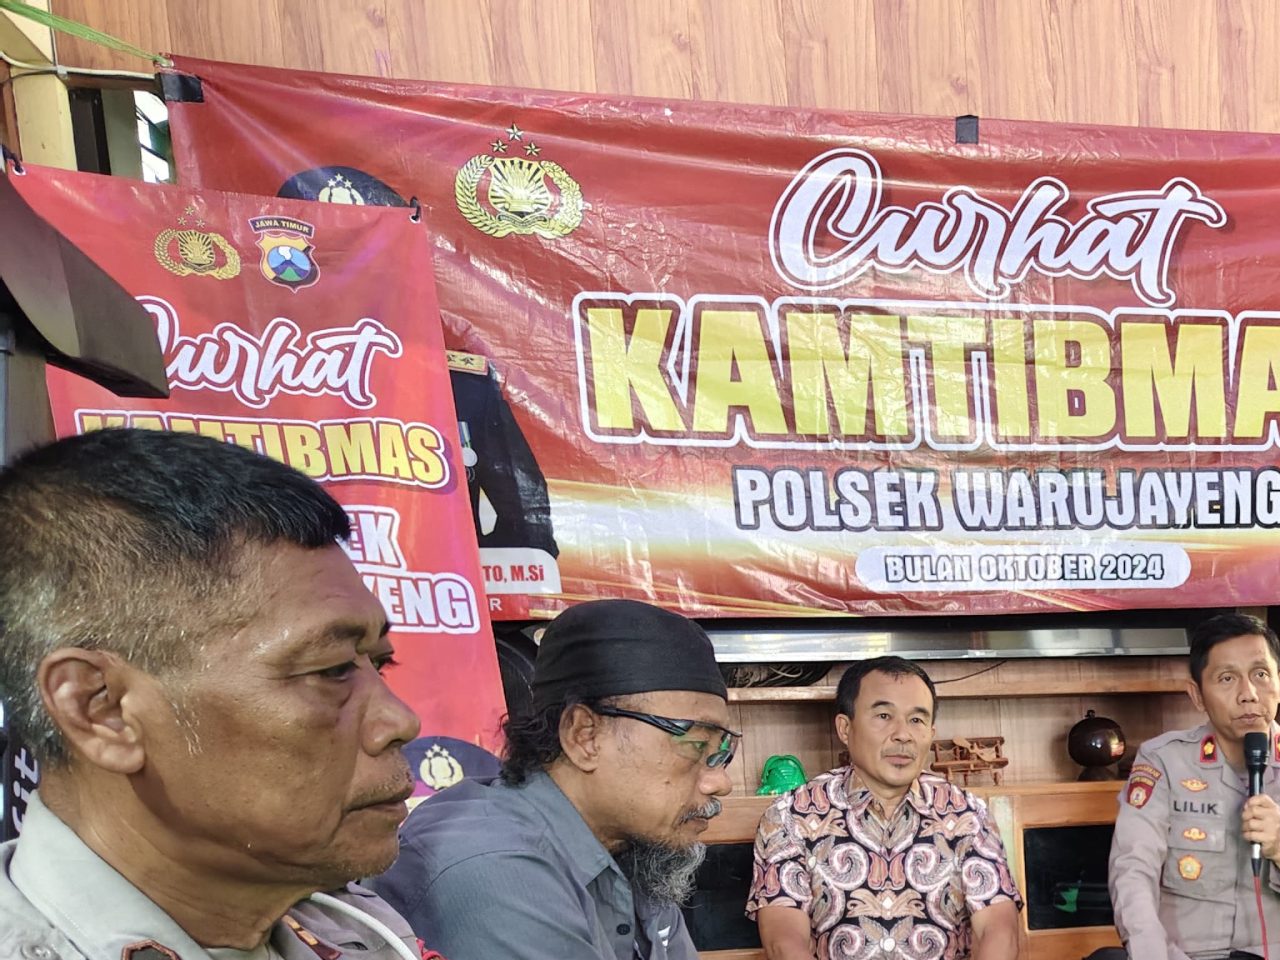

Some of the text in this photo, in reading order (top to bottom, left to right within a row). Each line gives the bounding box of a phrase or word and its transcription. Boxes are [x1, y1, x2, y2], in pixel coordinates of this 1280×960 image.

[255, 219, 309, 233] JAWA TIMUR
[771, 149, 1226, 305] Curhat
[735, 466, 943, 532] POLSEK
[510, 565, 544, 581] M.Si
[886, 554, 1165, 583] BULAN OKTOBER 2024
[1173, 800, 1218, 815] LILIK
